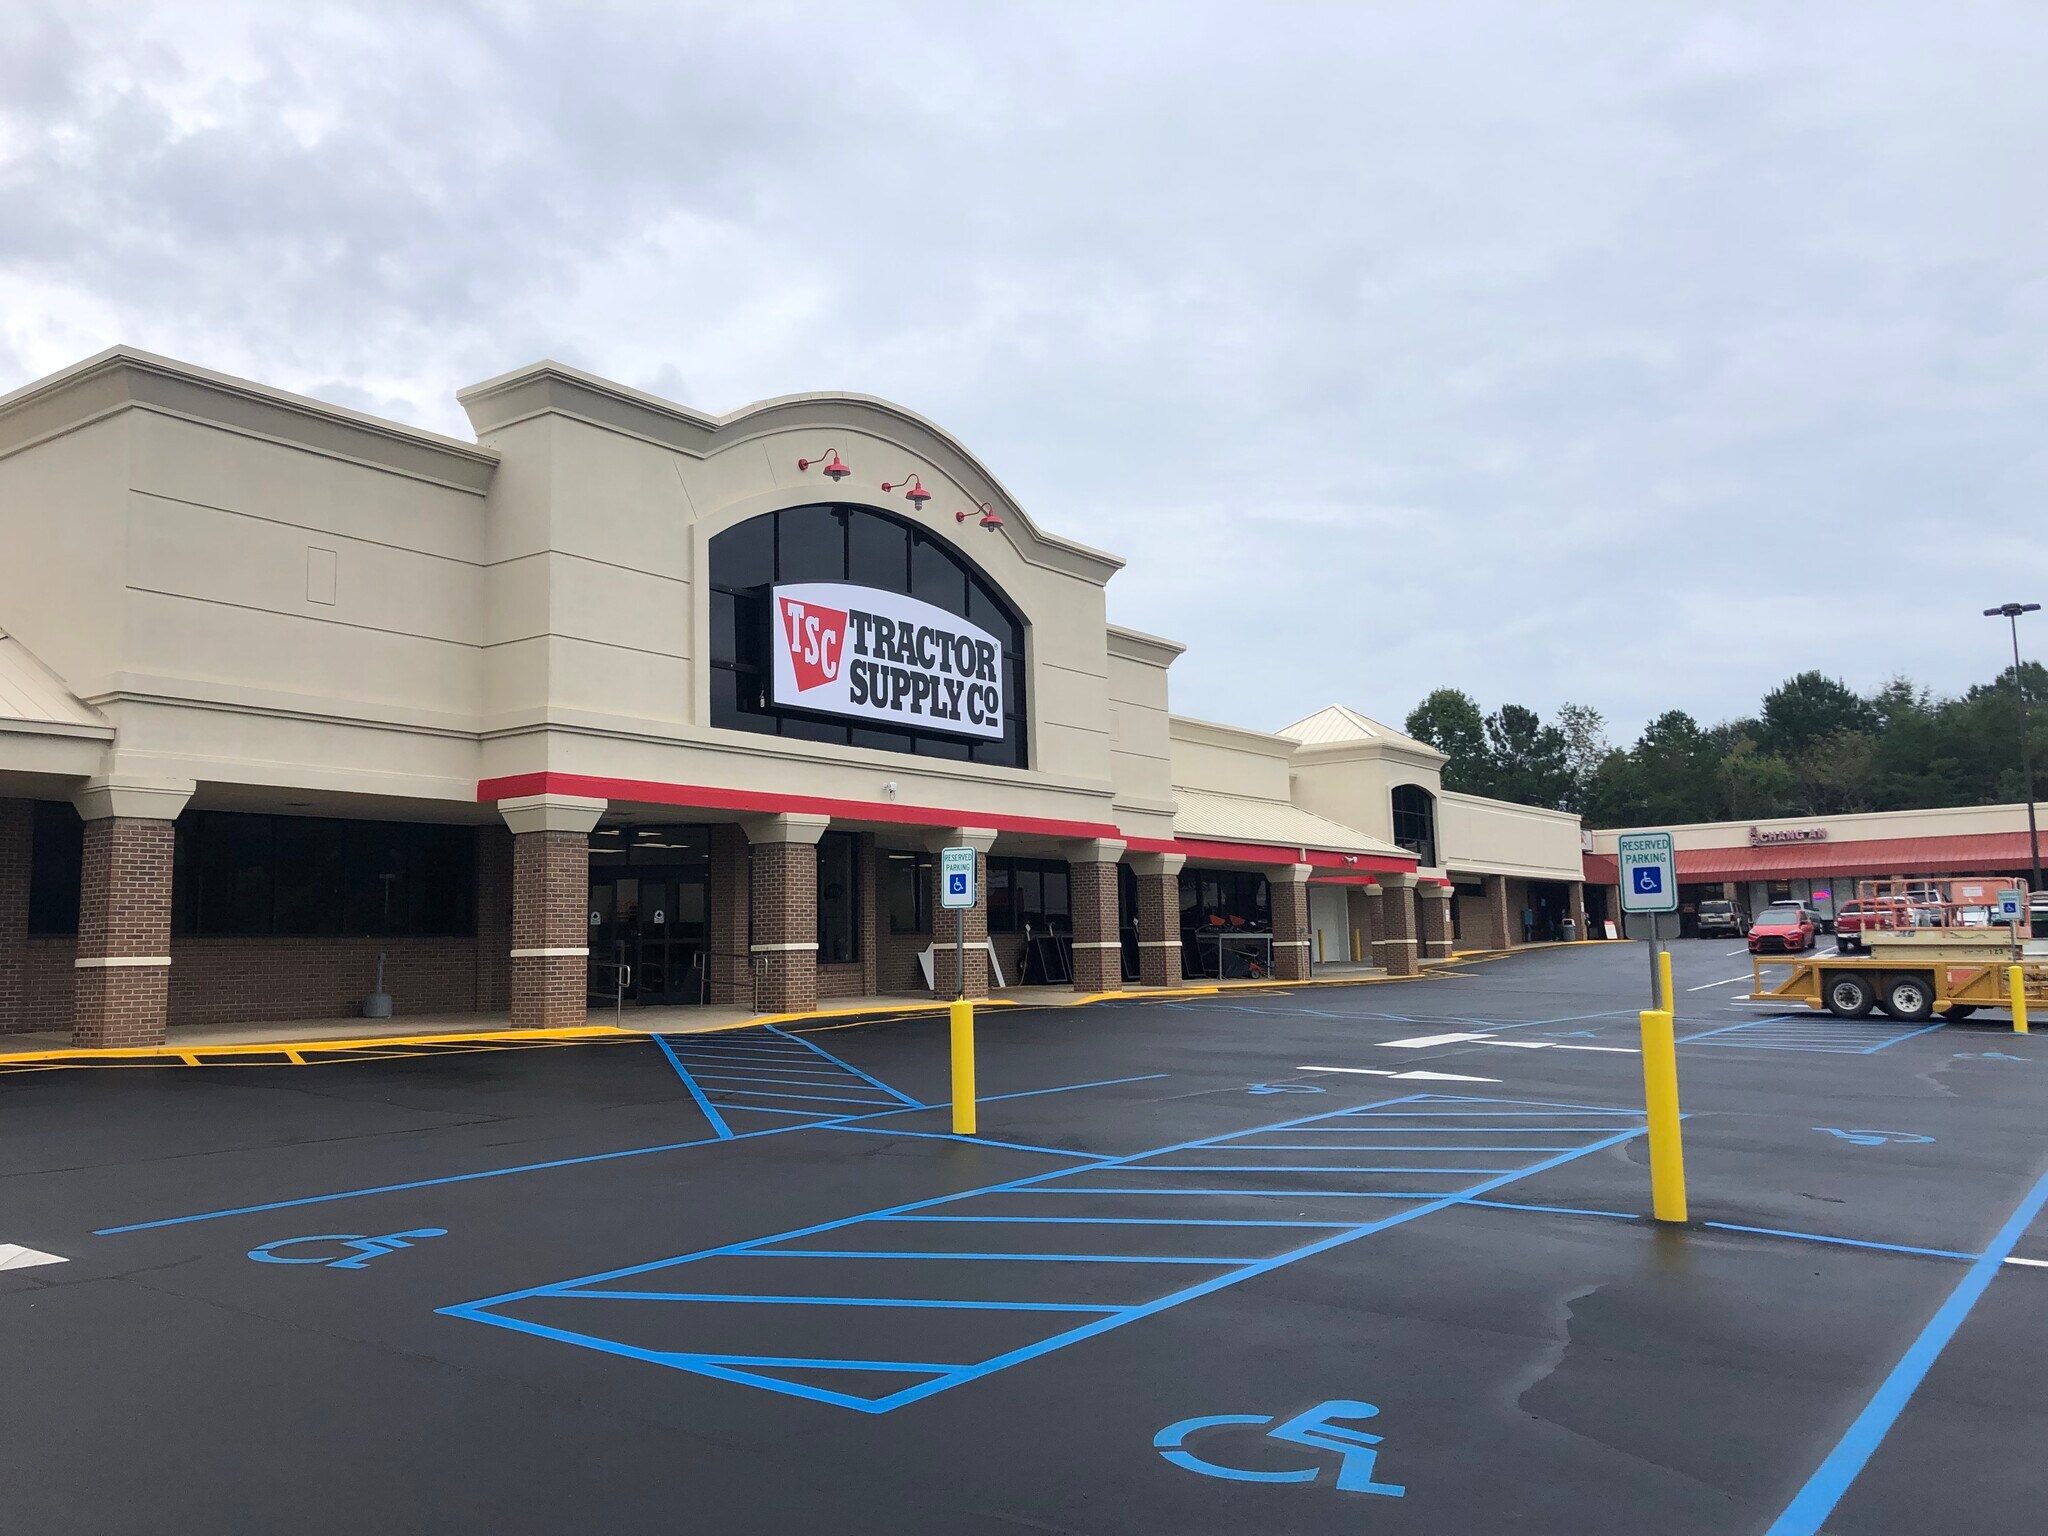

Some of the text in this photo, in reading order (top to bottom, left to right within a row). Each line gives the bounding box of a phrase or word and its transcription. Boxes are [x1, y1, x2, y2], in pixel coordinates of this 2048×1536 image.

[787, 602, 837, 679] TSC
[849, 608, 997, 683] TRACTOR
[850, 658, 964, 721] SUPPLY
[1760, 829, 1804, 841] CHANG
[1808, 828, 1827, 839] AN
[1622, 839, 1669, 851] RESERVED
[945, 853, 972, 862] RESERVED
[1625, 853, 1666, 864] PARKING
[946, 863, 970, 871] PARKING
